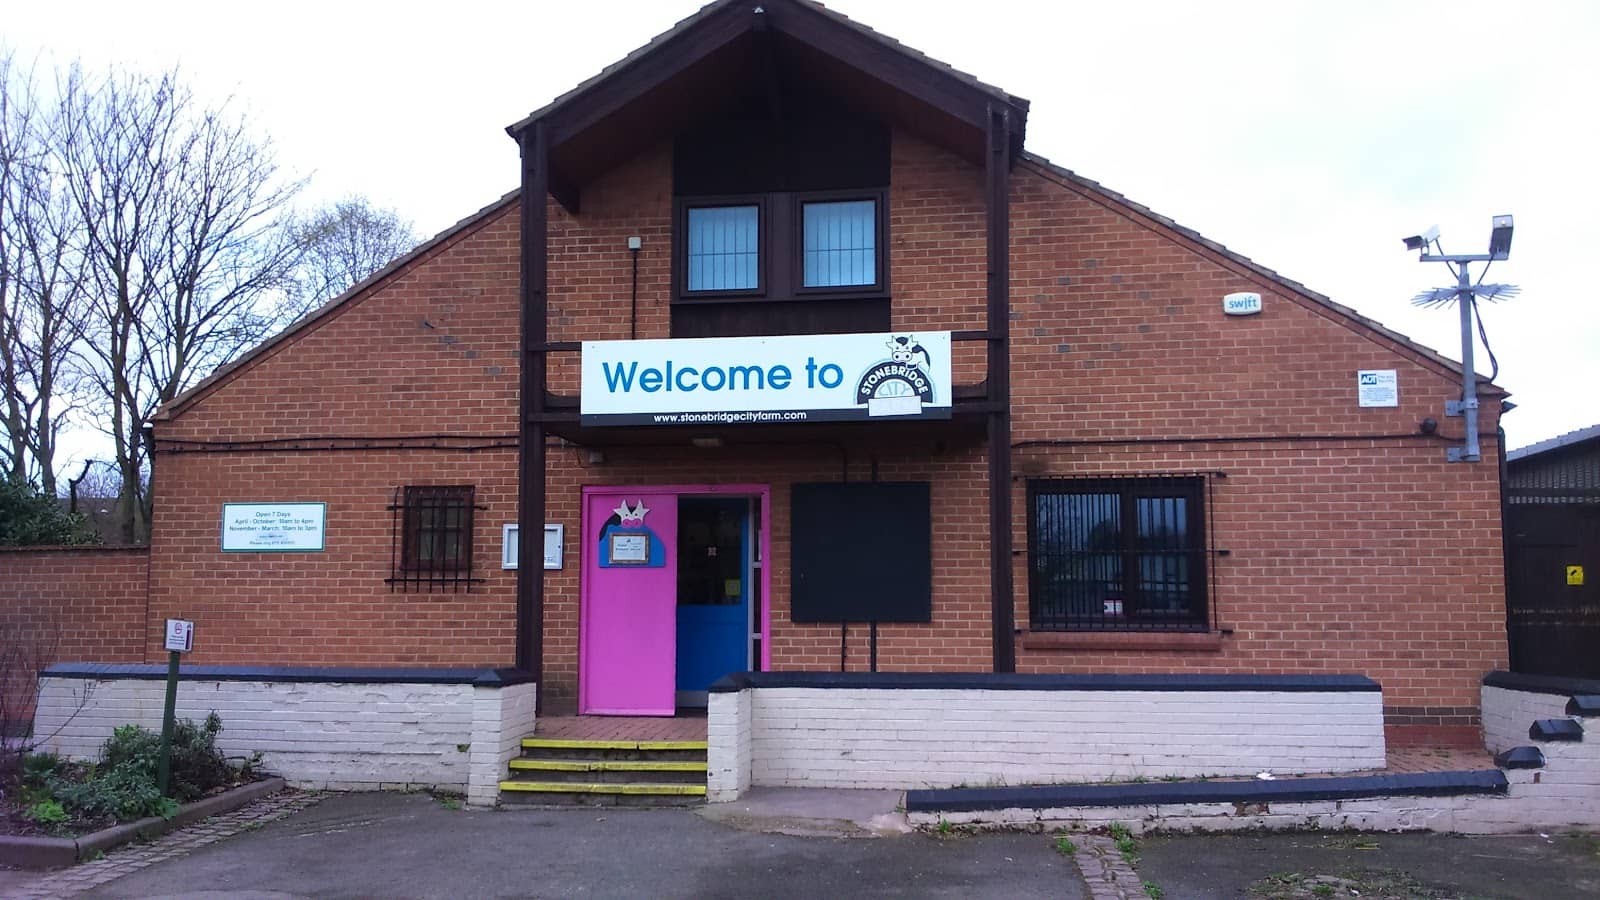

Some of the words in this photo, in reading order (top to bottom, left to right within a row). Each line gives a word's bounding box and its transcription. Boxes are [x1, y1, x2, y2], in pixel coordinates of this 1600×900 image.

[602, 360, 792, 393] Welcome
[805, 356, 844, 389] to
[862, 366, 928, 395] STONEBRIDGE
[1361, 374, 1378, 384] ADT
[653, 411, 807, 423] www.stonebridgecityfarm.com
